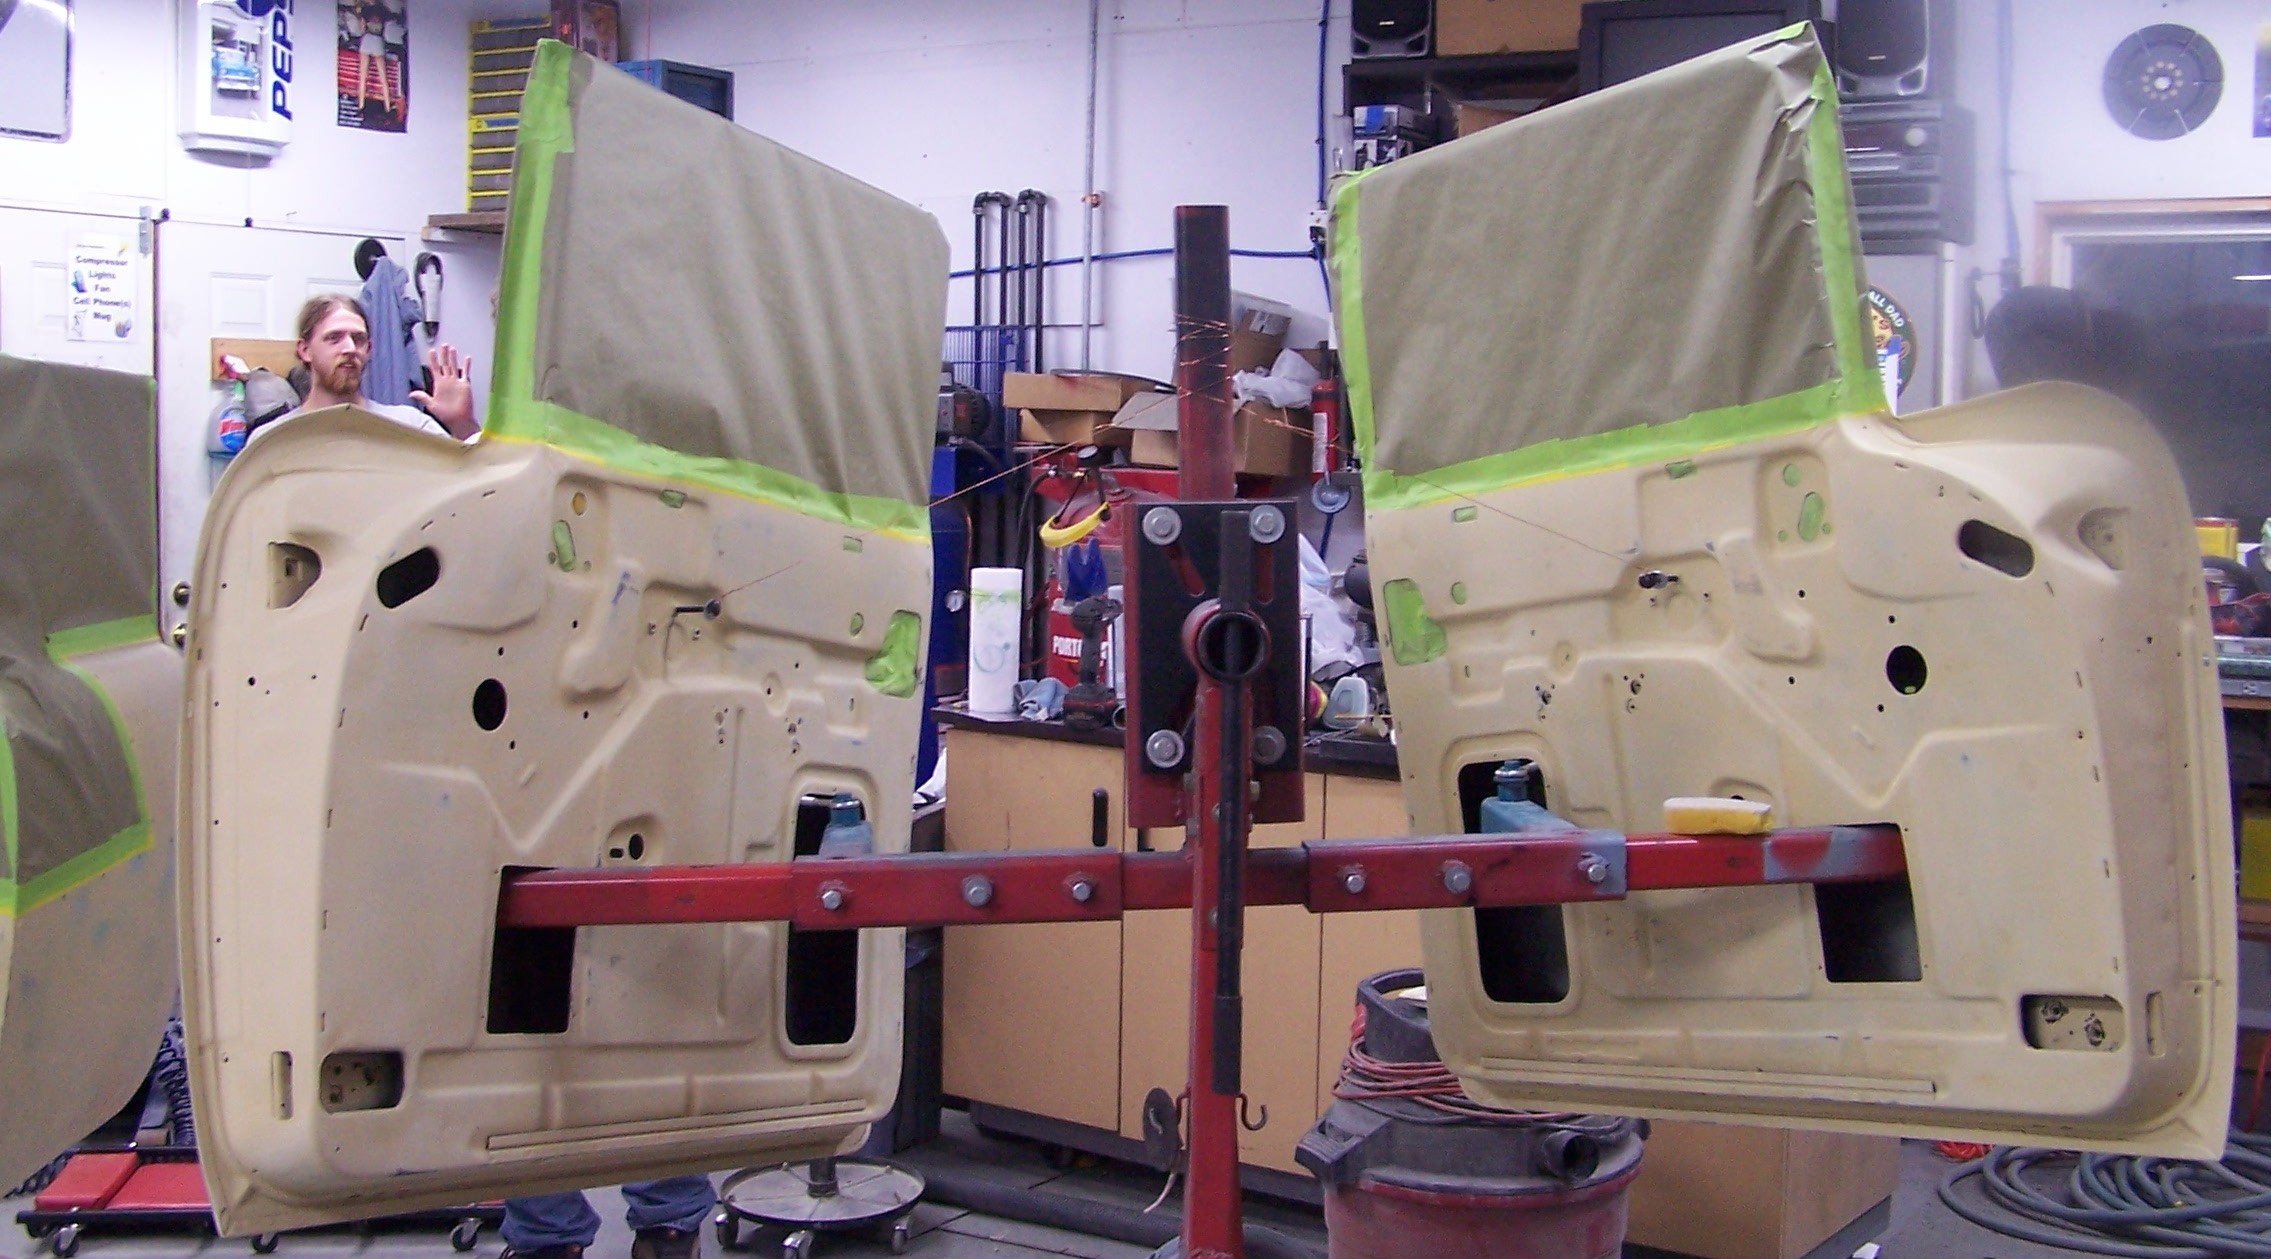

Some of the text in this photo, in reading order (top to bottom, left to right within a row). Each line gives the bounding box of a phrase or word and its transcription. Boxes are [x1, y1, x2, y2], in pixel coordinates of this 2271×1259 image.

[76, 255, 128, 267] Compressor
[89, 270, 116, 280] Lights
[94, 284, 111, 292] Fan
[73, 297, 131, 309] Cell Phone(s)
[93, 312, 112, 322] Mug
[1885, 304, 1905, 328] DAD
